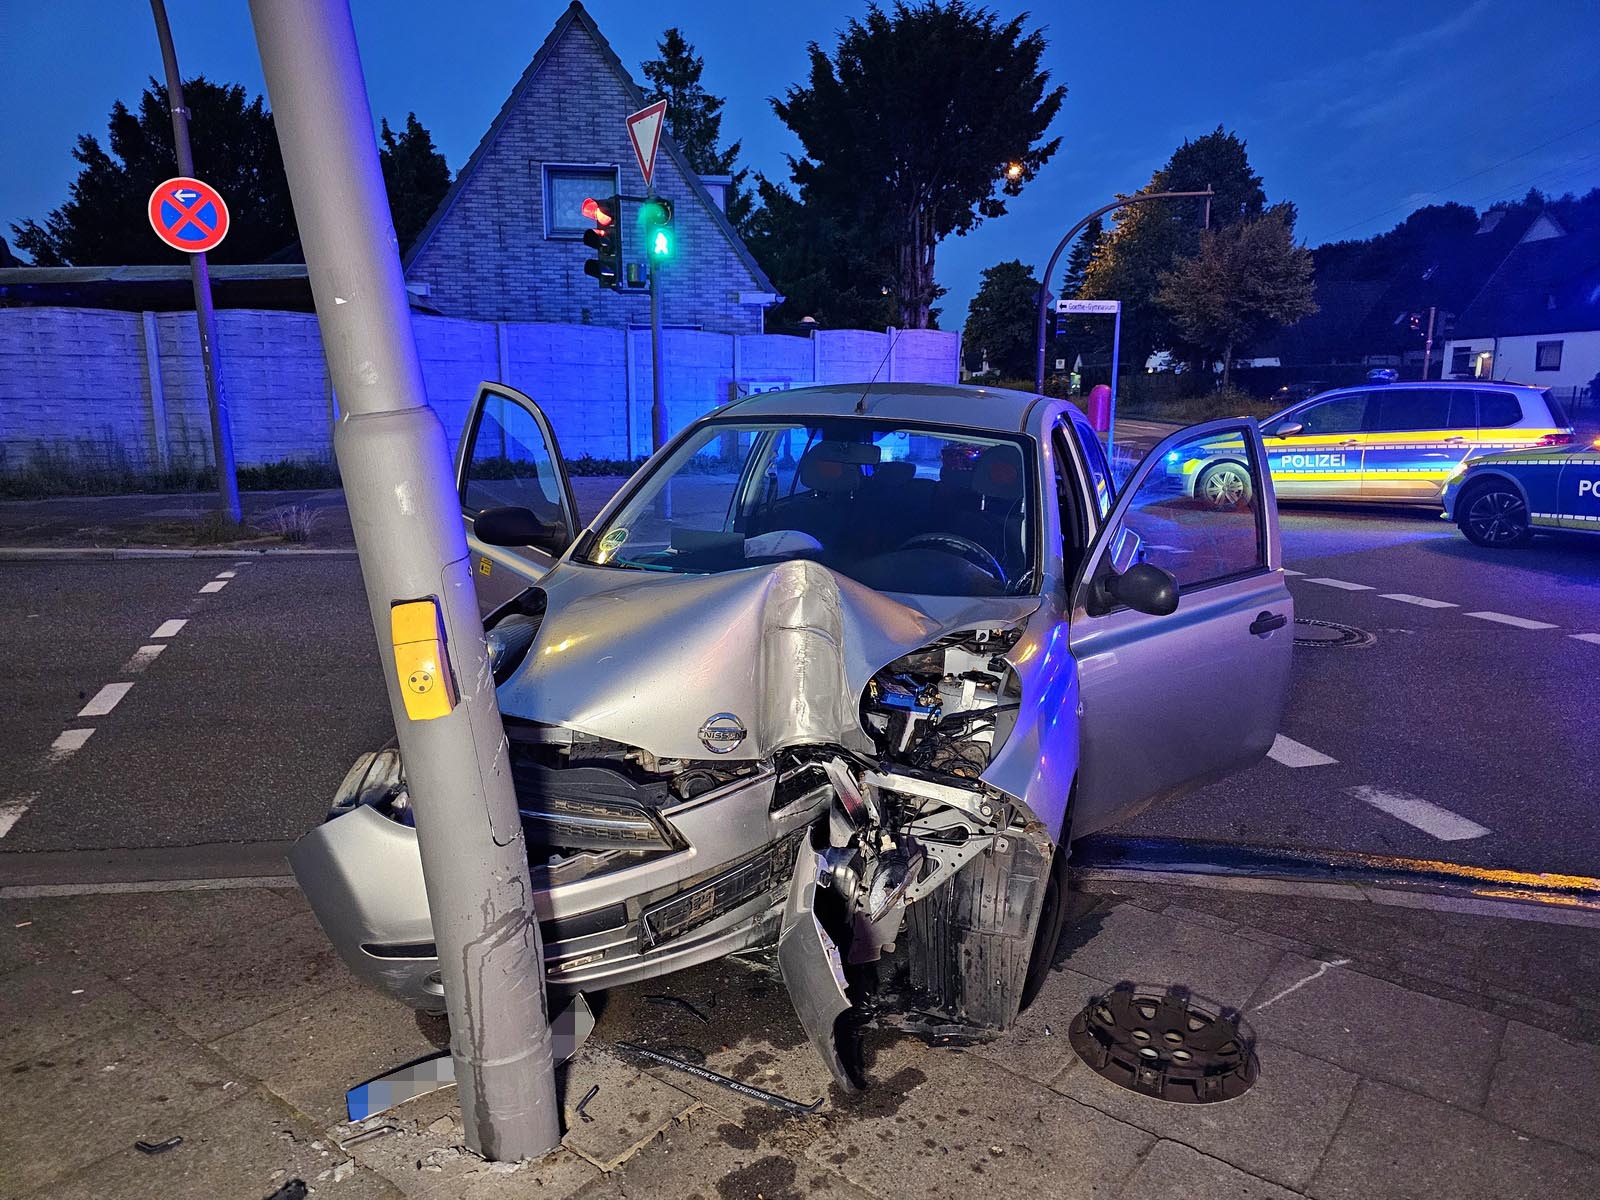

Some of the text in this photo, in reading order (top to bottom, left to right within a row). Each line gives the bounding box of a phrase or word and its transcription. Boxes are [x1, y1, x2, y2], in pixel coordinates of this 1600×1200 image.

[1281, 454, 1346, 468] POLIZEI
[703, 731, 743, 739] NISSAN
[730, 1083, 771, 1100] ELMSHORN
